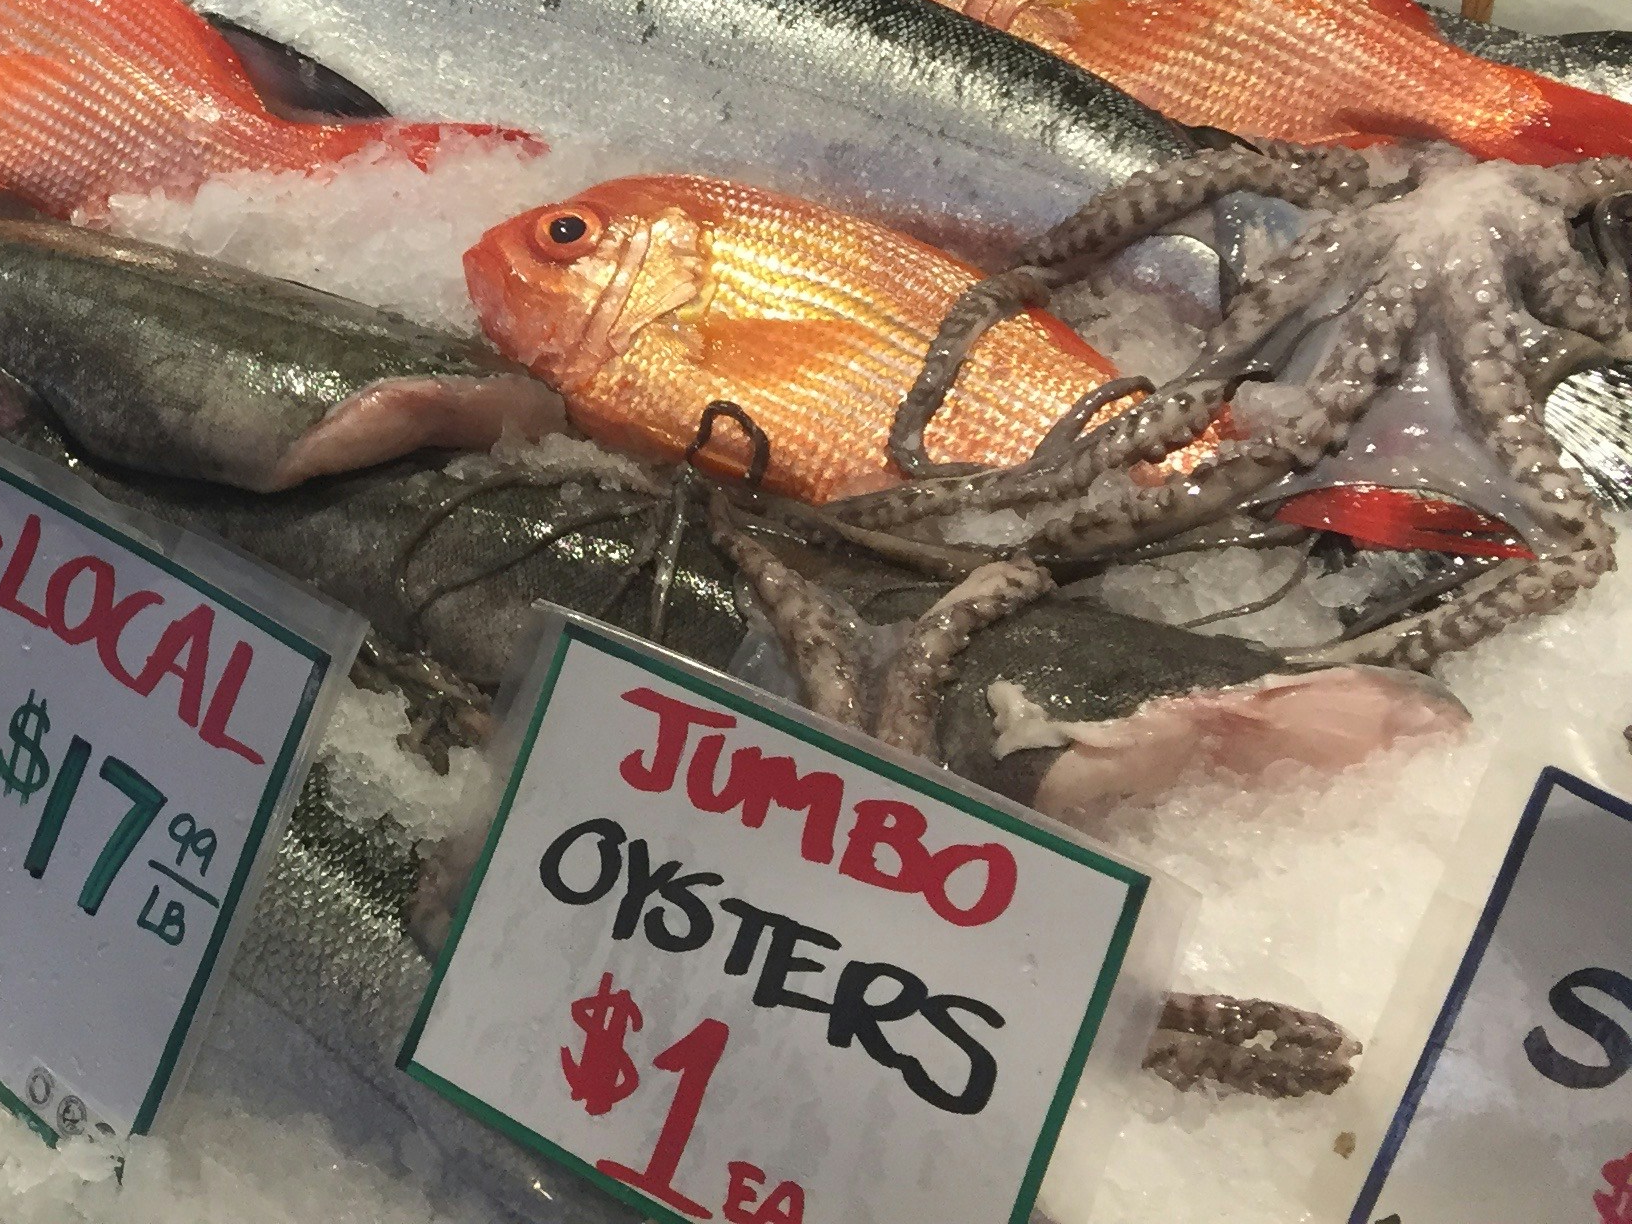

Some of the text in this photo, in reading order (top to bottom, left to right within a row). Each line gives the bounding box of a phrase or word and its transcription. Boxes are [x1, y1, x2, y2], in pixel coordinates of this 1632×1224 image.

[167, 812, 220, 879] 99
[618, 687, 1018, 927] JUMBO
[135, 882, 188, 946] LB
[538, 817, 1006, 1115] OYSTERS
[560, 972, 806, 1224] $1 EA
[1524, 967, 1632, 1090] S
